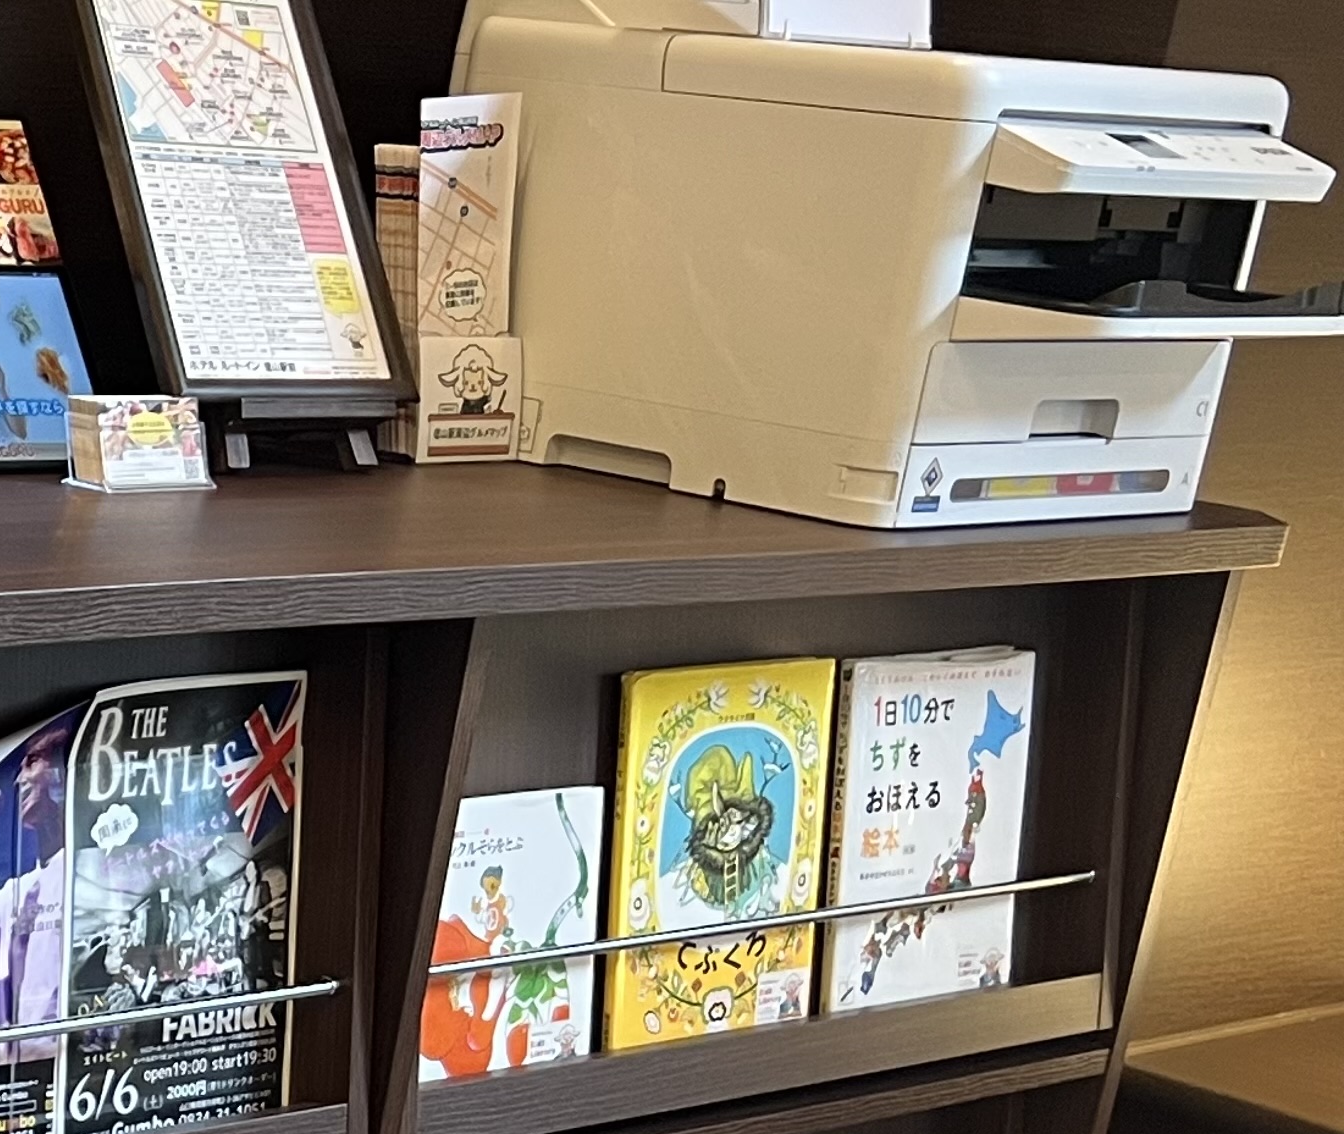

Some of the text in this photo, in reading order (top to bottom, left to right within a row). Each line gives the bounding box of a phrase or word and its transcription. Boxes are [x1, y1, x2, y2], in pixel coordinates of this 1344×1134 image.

[131, 705, 169, 739] THE
[873, 693, 956, 727] 1日10分で
[869, 736, 922, 771] ちずを
[860, 824, 900, 859] 絵本
[144, 1047, 277, 1084] open19:00 start19:30
[69, 1066, 139, 1122] 6/6
[167, 1079, 207, 1100] 2000円
